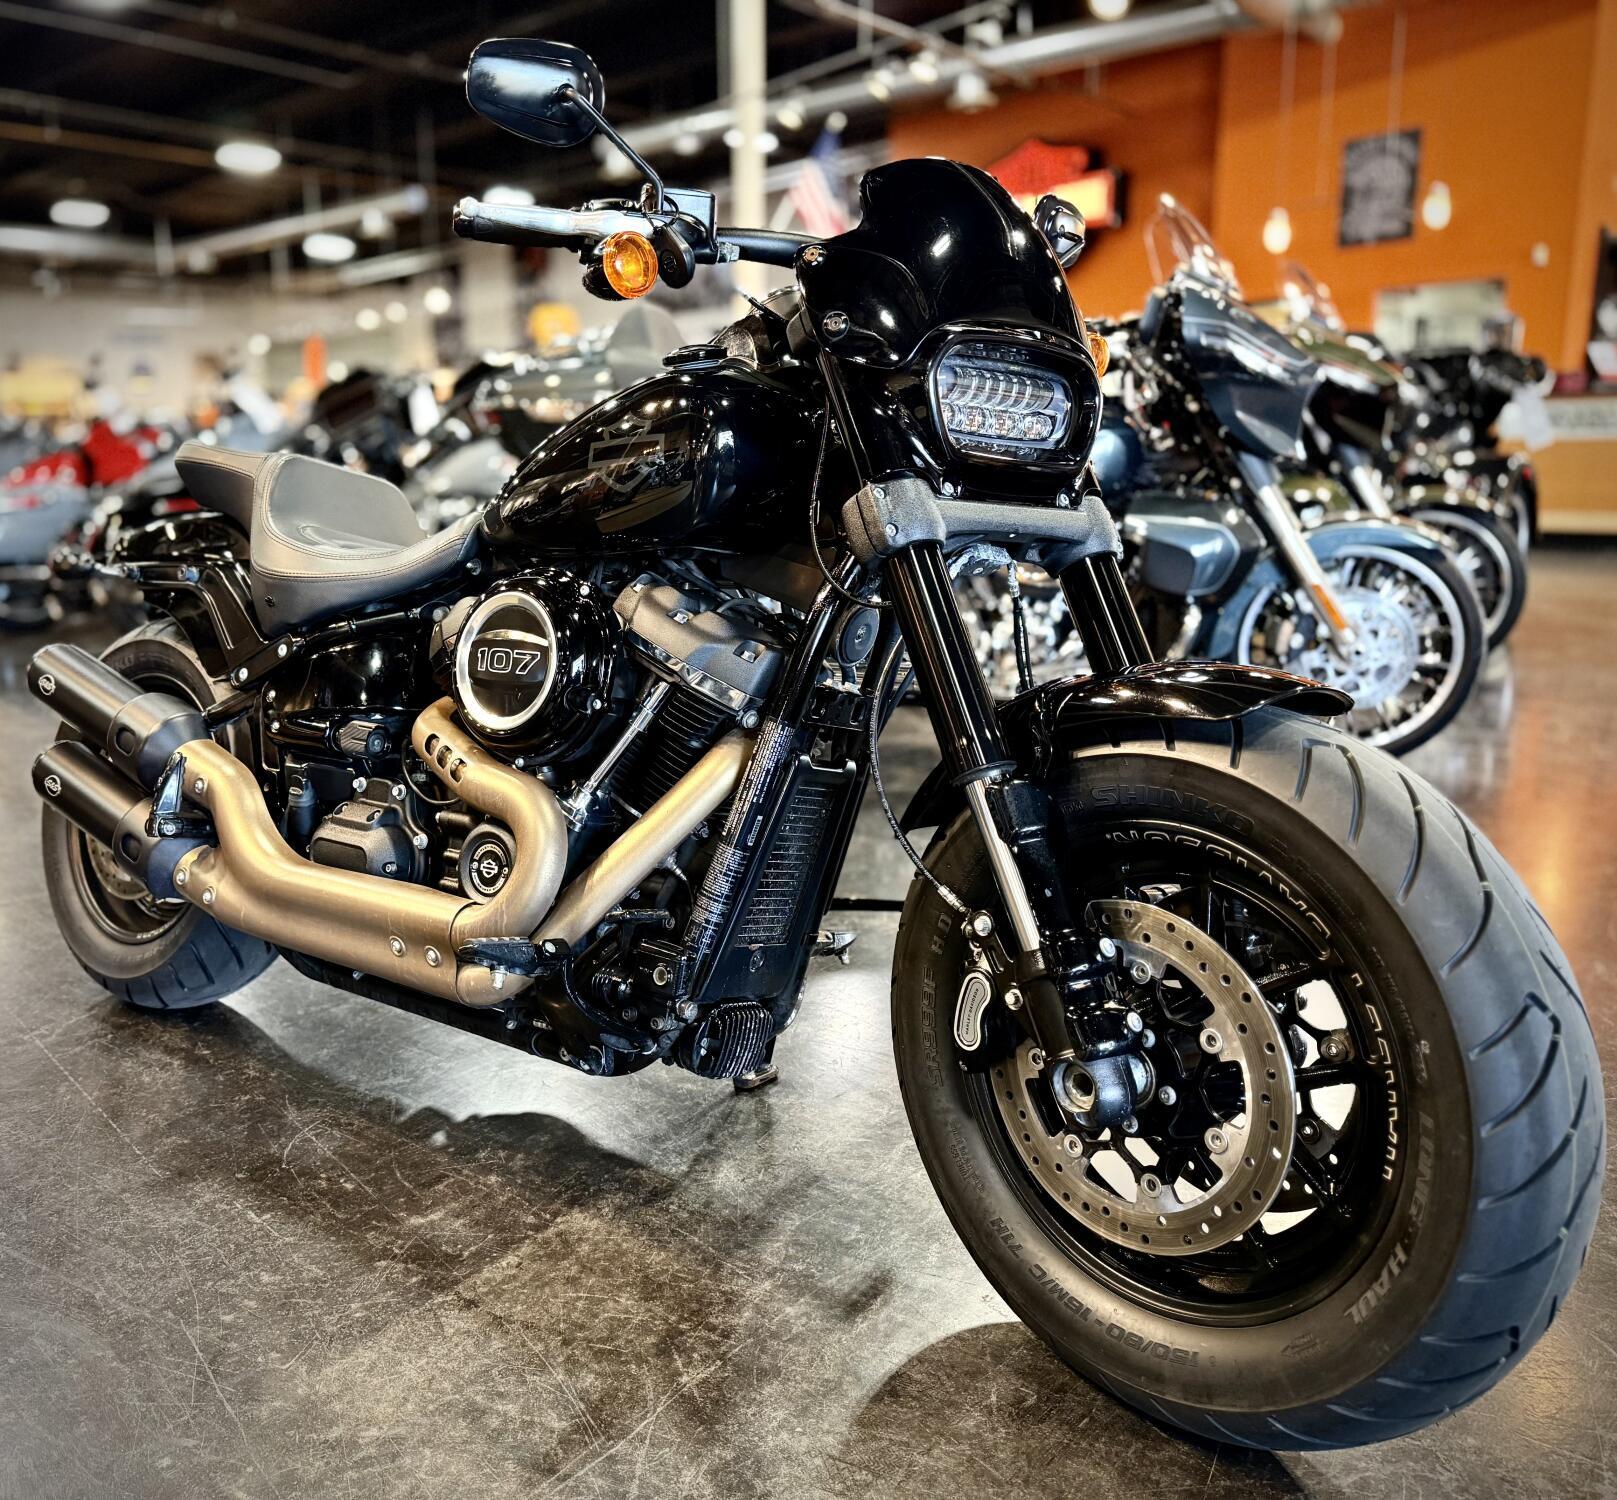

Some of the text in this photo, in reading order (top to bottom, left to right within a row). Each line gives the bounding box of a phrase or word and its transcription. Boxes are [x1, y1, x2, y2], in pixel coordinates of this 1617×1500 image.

[477, 646, 541, 675] 107
[1091, 783, 1255, 838] SHINKO
[964, 988, 980, 1036] HARLEY-DAVIDSON
[1343, 1241, 1409, 1326] HAUL
